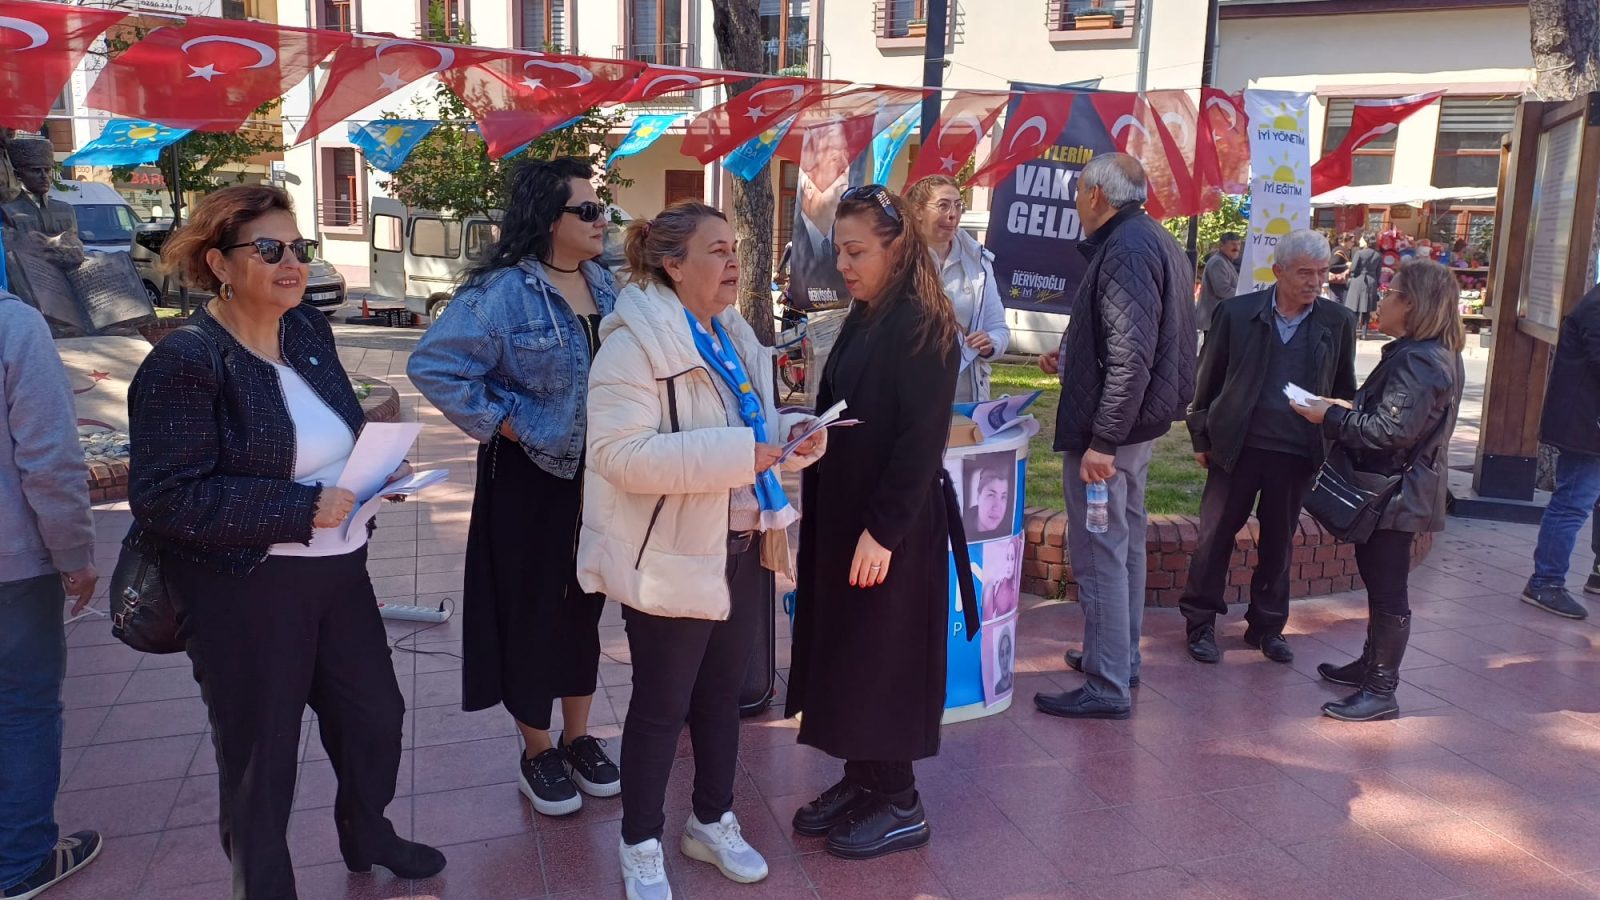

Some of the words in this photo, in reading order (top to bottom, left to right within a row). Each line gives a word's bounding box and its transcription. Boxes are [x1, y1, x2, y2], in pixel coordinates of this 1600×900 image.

[1258, 129, 1271, 141] İYİ
[1273, 130, 1305, 146] YÖNETİM
[1264, 181, 1274, 193] İYİ
[1276, 183, 1302, 196] EĞİTİM
